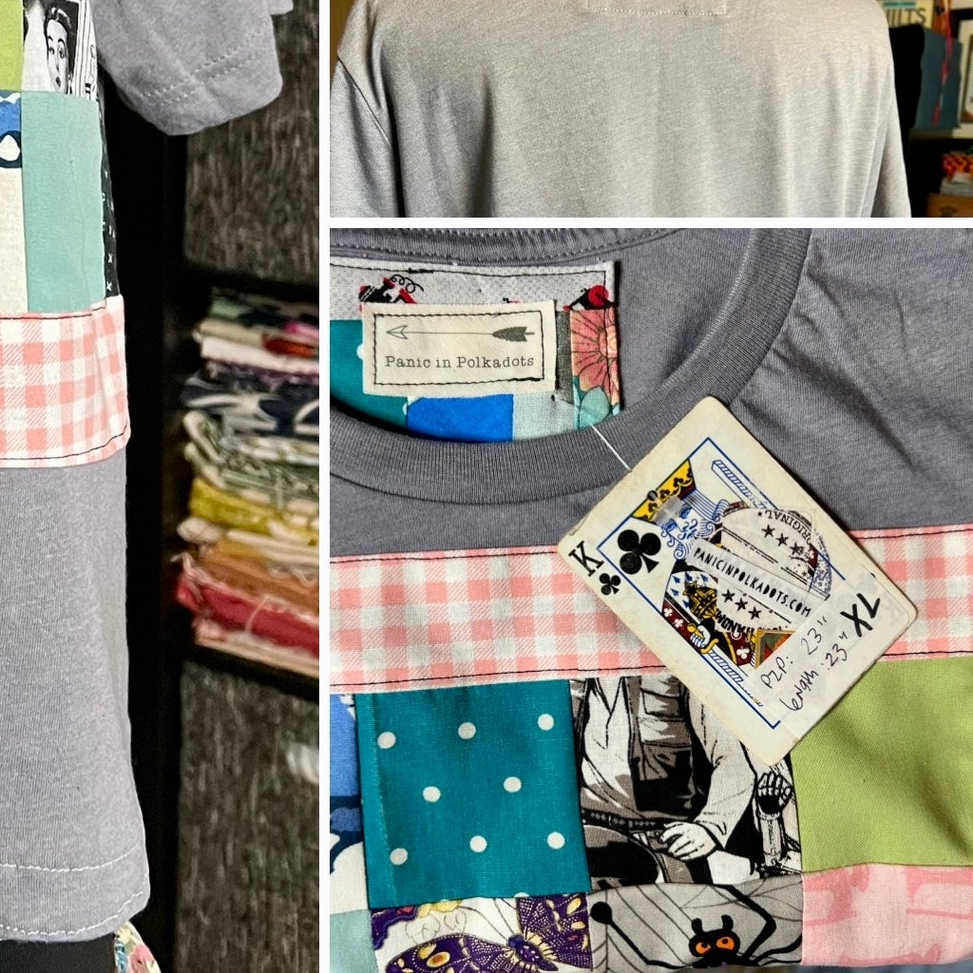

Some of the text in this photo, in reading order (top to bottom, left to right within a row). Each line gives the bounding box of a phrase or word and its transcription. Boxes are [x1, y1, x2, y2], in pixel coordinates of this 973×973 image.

[385, 355, 534, 369] Panic in Polkadots
[568, 540, 605, 577] K
[693, 547, 811, 618] PANICINPOLKADOTS.COM
[839, 593, 881, 637] XL
